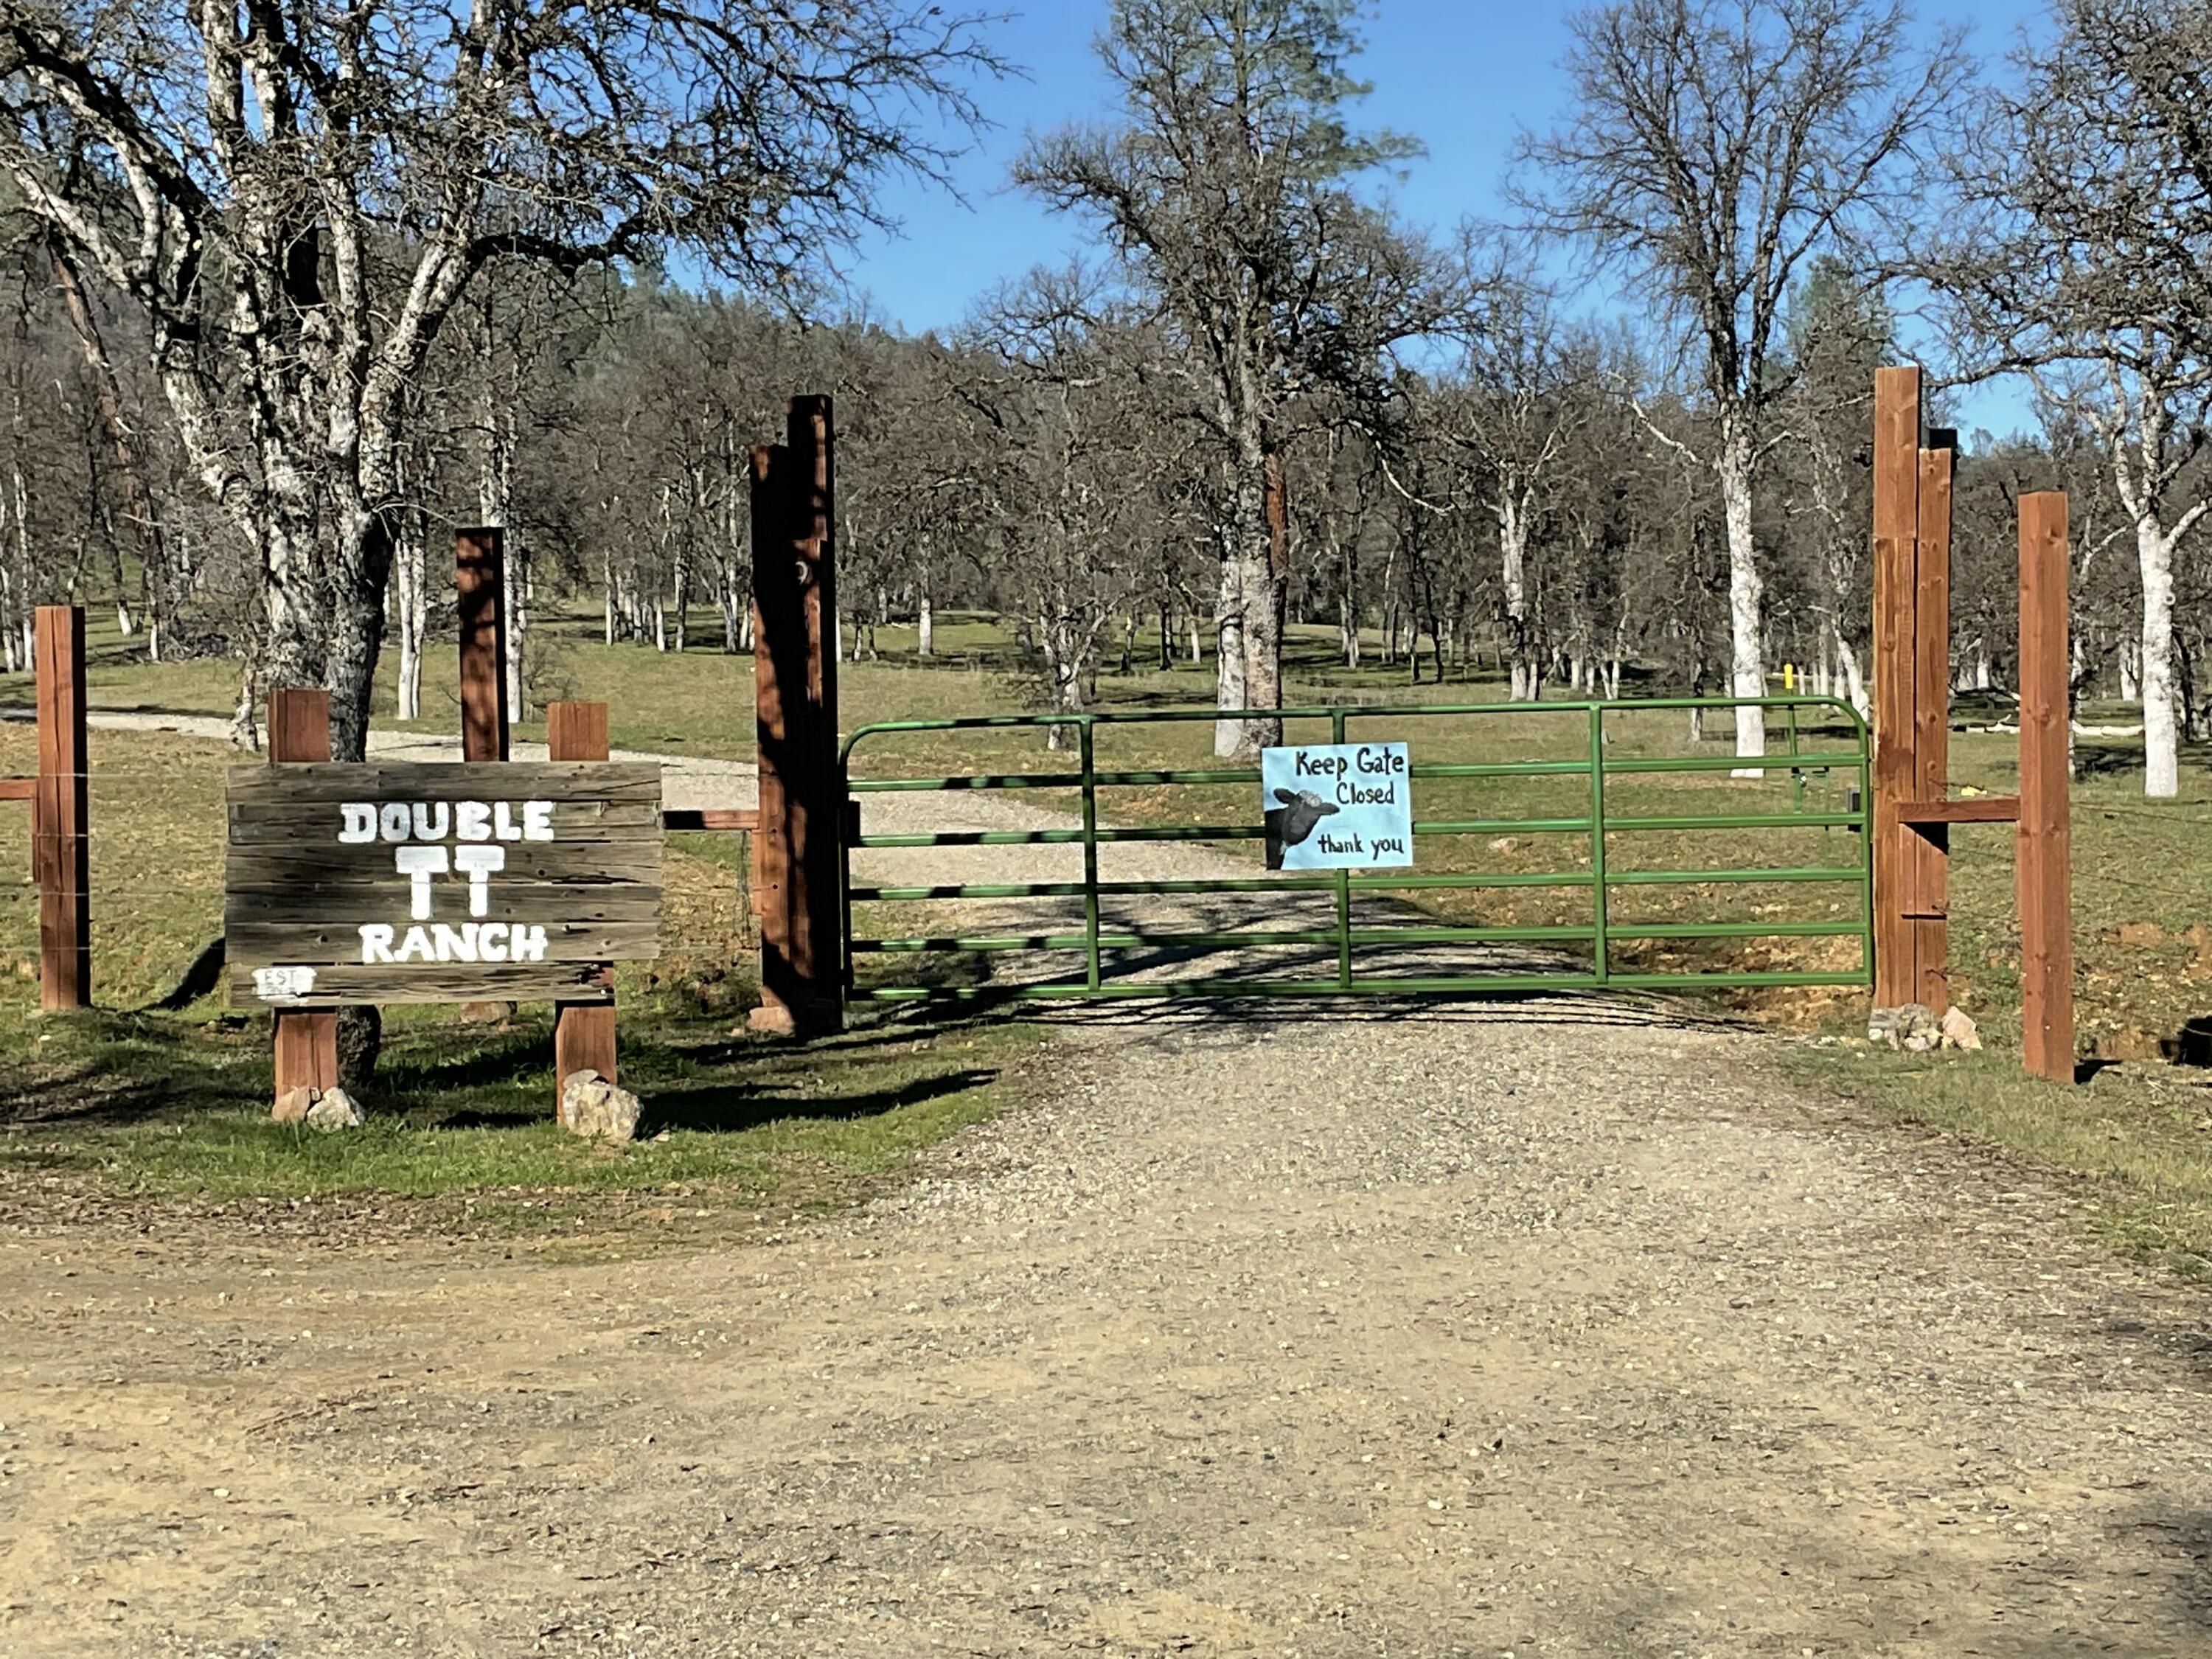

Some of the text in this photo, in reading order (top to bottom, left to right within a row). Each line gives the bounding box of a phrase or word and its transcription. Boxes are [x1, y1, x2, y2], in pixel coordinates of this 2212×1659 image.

[1295, 747, 1404, 782] Keep Gate
[1336, 781, 1395, 804] Closed
[338, 801, 554, 843] DOUBLE
[1318, 832, 1404, 860] thank you
[395, 845, 505, 921] TT
[358, 923, 549, 964] RANCH
[265, 970, 297, 986] EST
